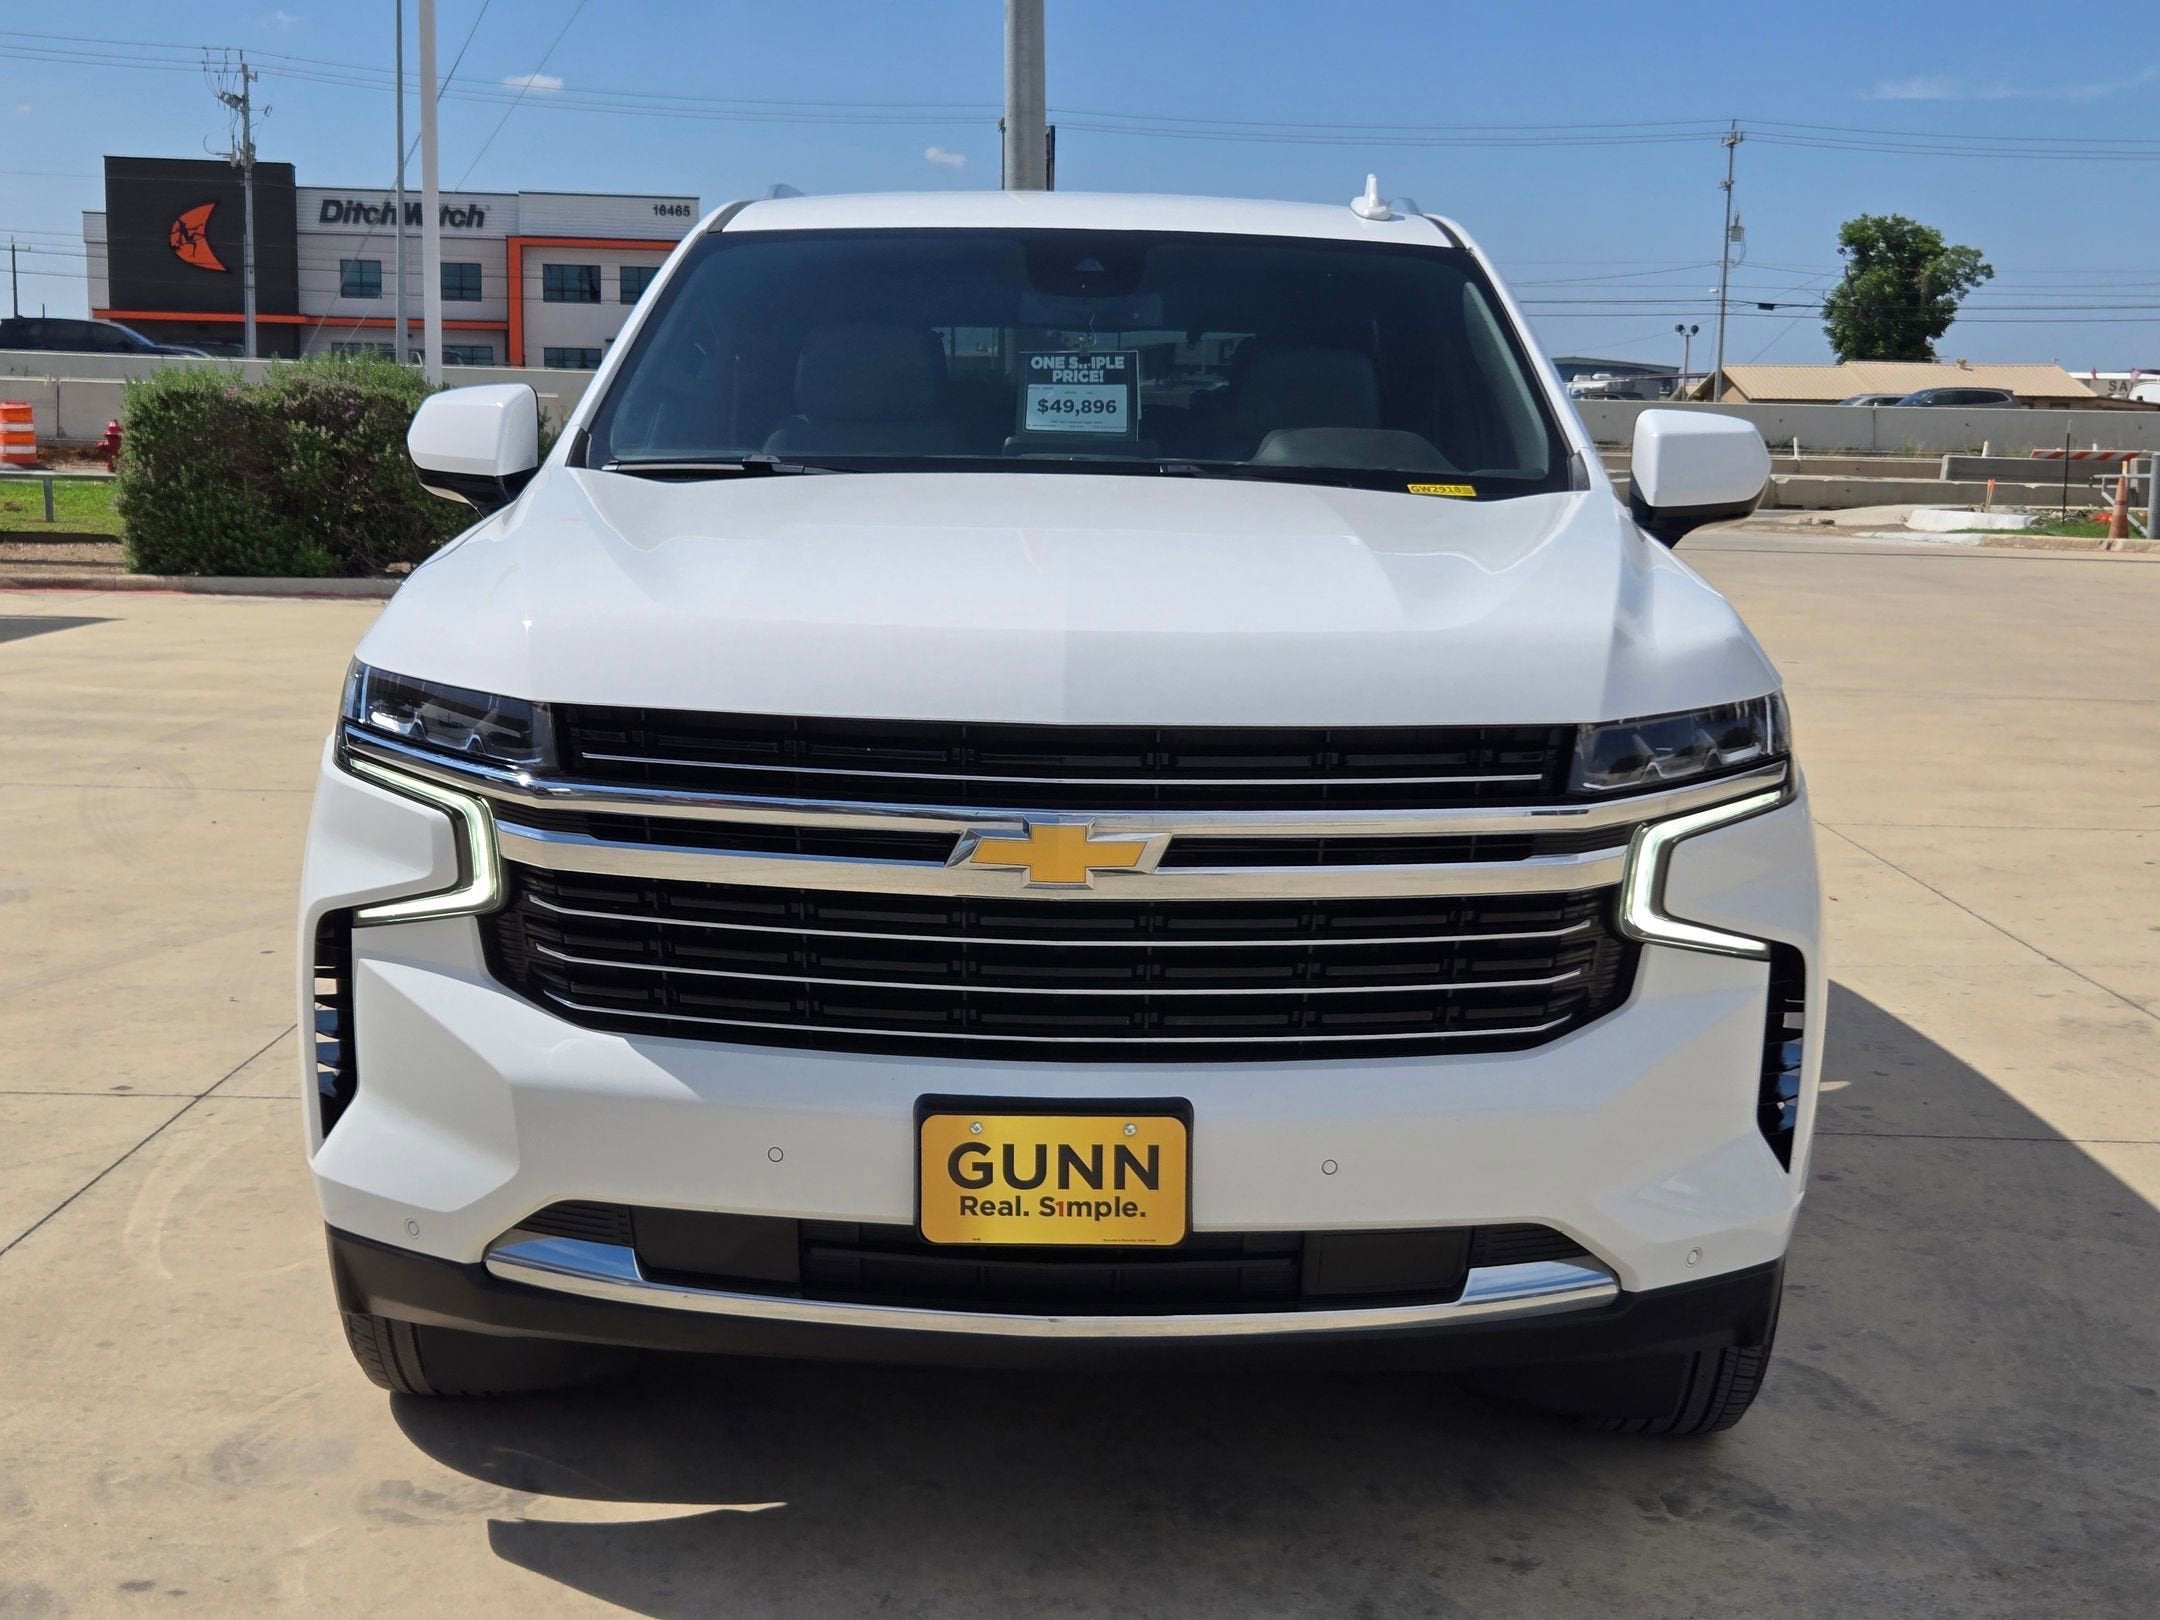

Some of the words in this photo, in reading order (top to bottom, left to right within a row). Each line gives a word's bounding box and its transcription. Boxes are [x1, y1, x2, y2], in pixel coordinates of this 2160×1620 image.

[319, 199, 397, 225] Ditch
[404, 202, 485, 228] Wtch
[653, 204, 690, 217] 16465
[1030, 356, 1065, 369] ONE
[1052, 370, 1104, 383] PRICE!
[1037, 398, 1117, 416] $49,896
[947, 1141, 1160, 1190] GUNN
[959, 1195, 1030, 1217] Real.
